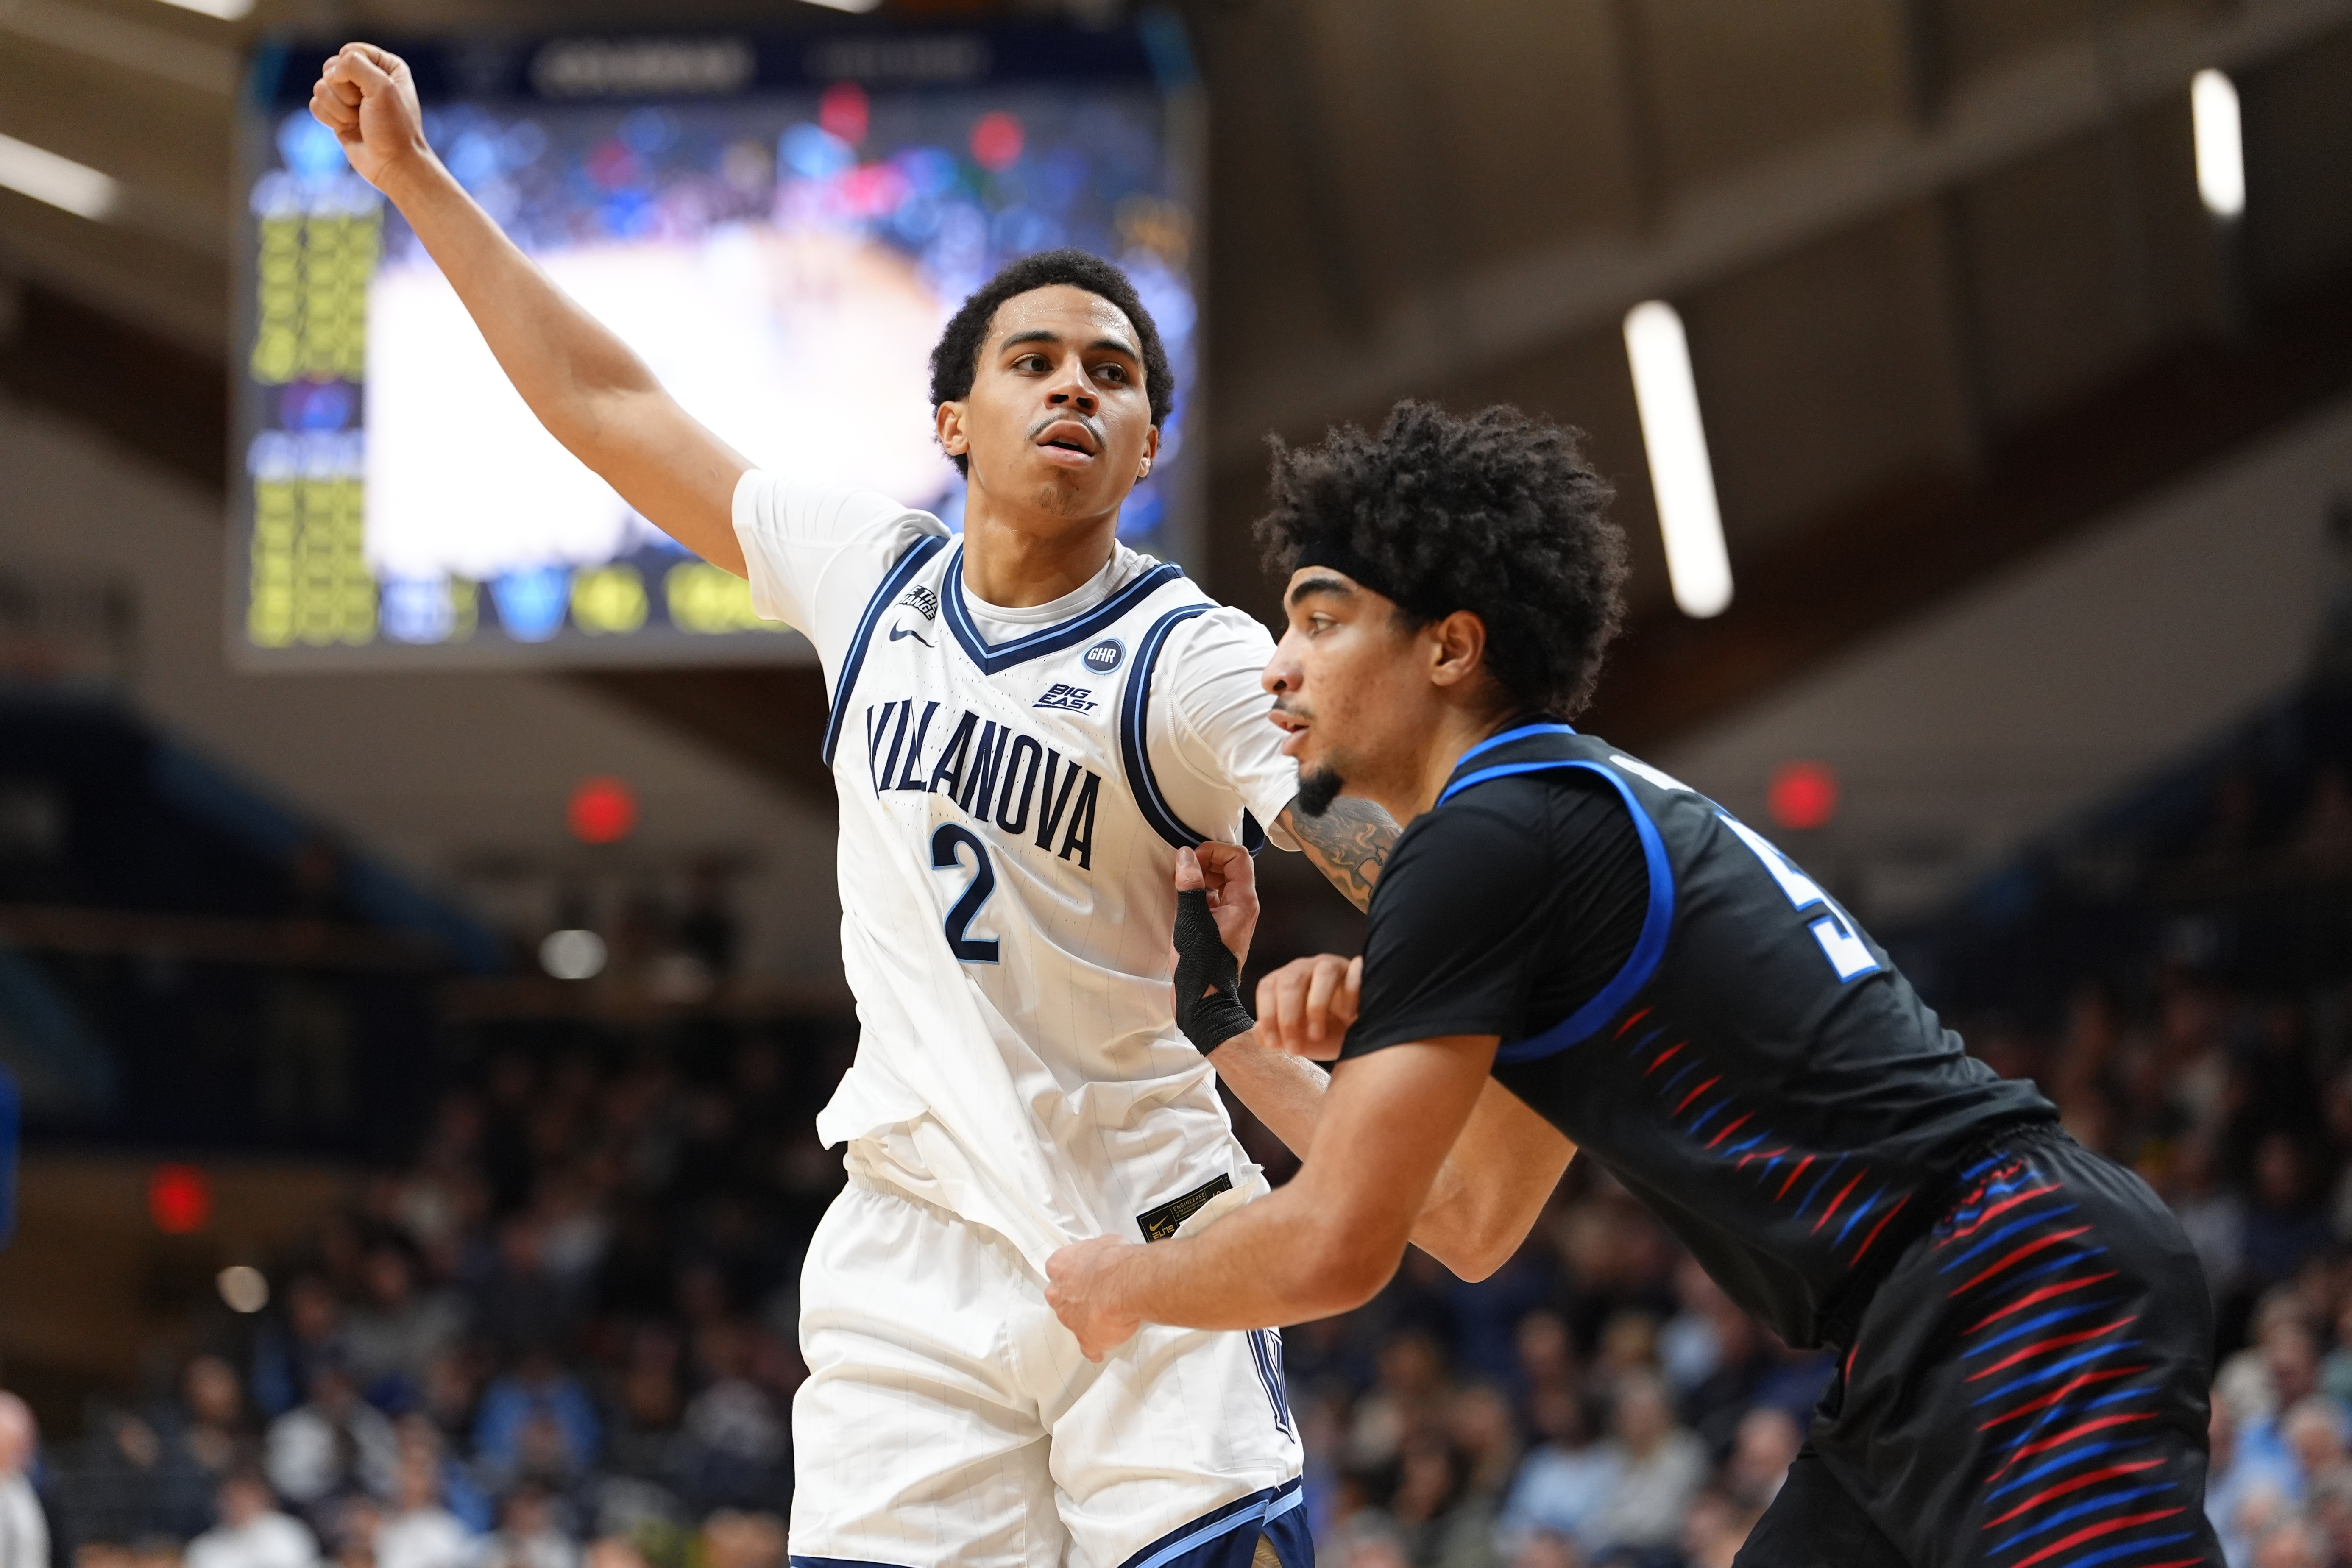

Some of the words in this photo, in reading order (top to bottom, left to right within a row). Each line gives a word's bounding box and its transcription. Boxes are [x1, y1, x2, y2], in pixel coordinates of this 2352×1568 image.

[919, 589, 938, 612] THE
[1088, 647, 1117, 664] GHR
[1048, 683, 1092, 699] BIG
[1038, 693, 1098, 710] EAST
[929, 821, 1000, 965] 2
[1173, 1192, 1205, 1212] ENGINEERED
[1152, 1224, 1175, 1239] ELITE
